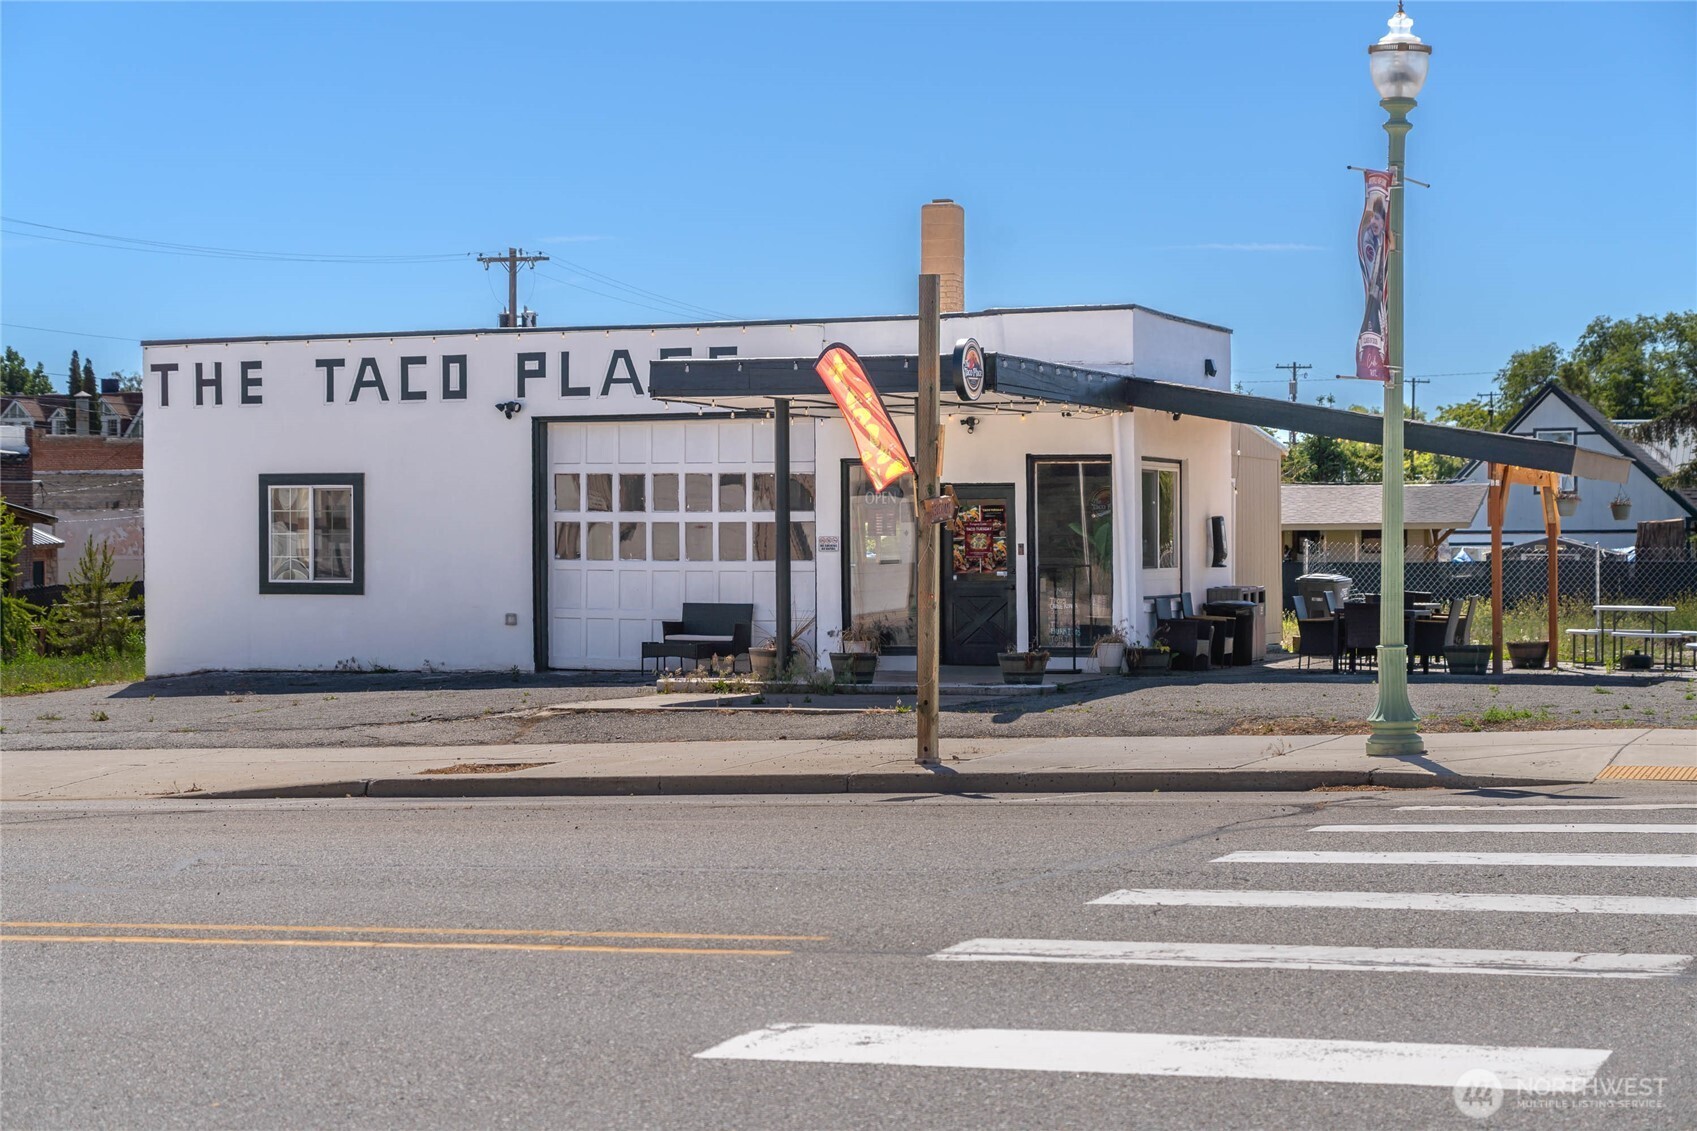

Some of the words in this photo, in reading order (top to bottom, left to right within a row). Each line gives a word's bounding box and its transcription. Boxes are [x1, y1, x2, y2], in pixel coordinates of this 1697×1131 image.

[150, 360, 263, 407] THE
[315, 354, 468, 402] TACO
[517, 346, 738, 398] PLA
[865, 491, 897, 505] OPEN
